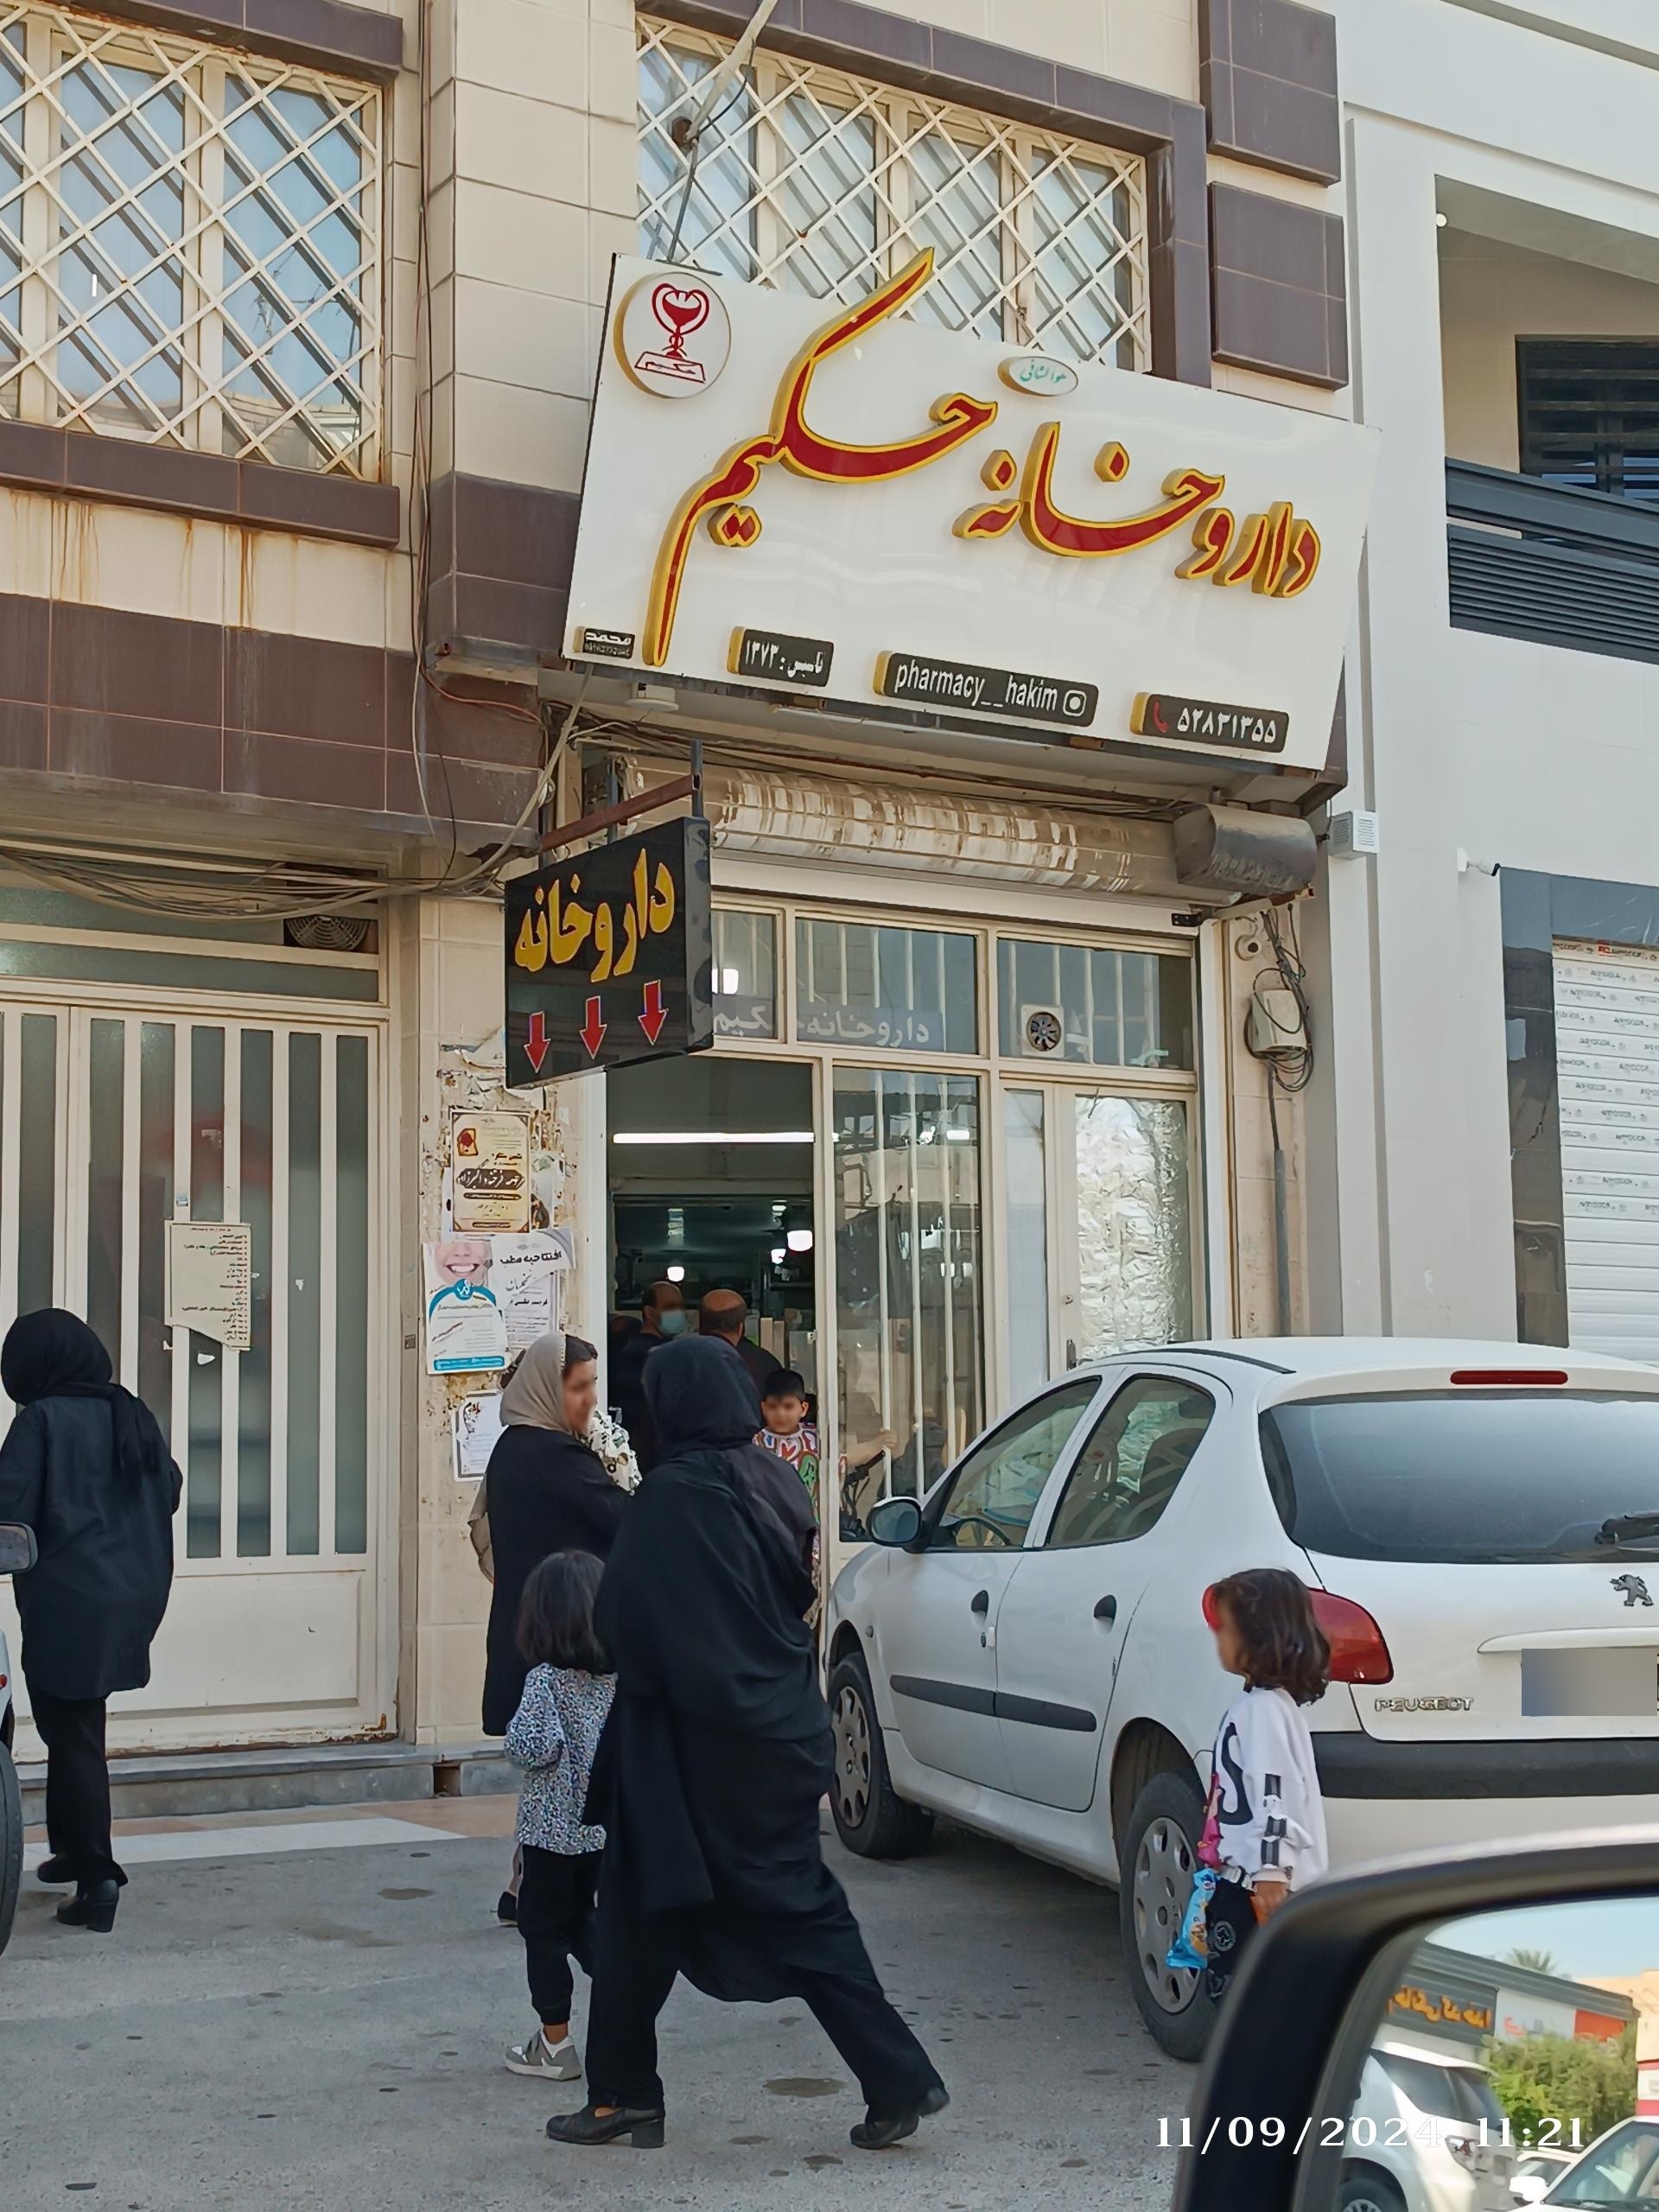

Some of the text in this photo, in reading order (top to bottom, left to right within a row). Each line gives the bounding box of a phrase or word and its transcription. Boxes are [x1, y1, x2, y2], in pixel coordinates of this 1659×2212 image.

[644, 247, 1321, 667] داروخانه حکیم
[585, 631, 632, 646] محمد
[514, 848, 675, 983] داروخانه
[714, 1004, 930, 1048] داروخانه کیم
[1374, 1695, 1474, 1713] PEUGEOT
